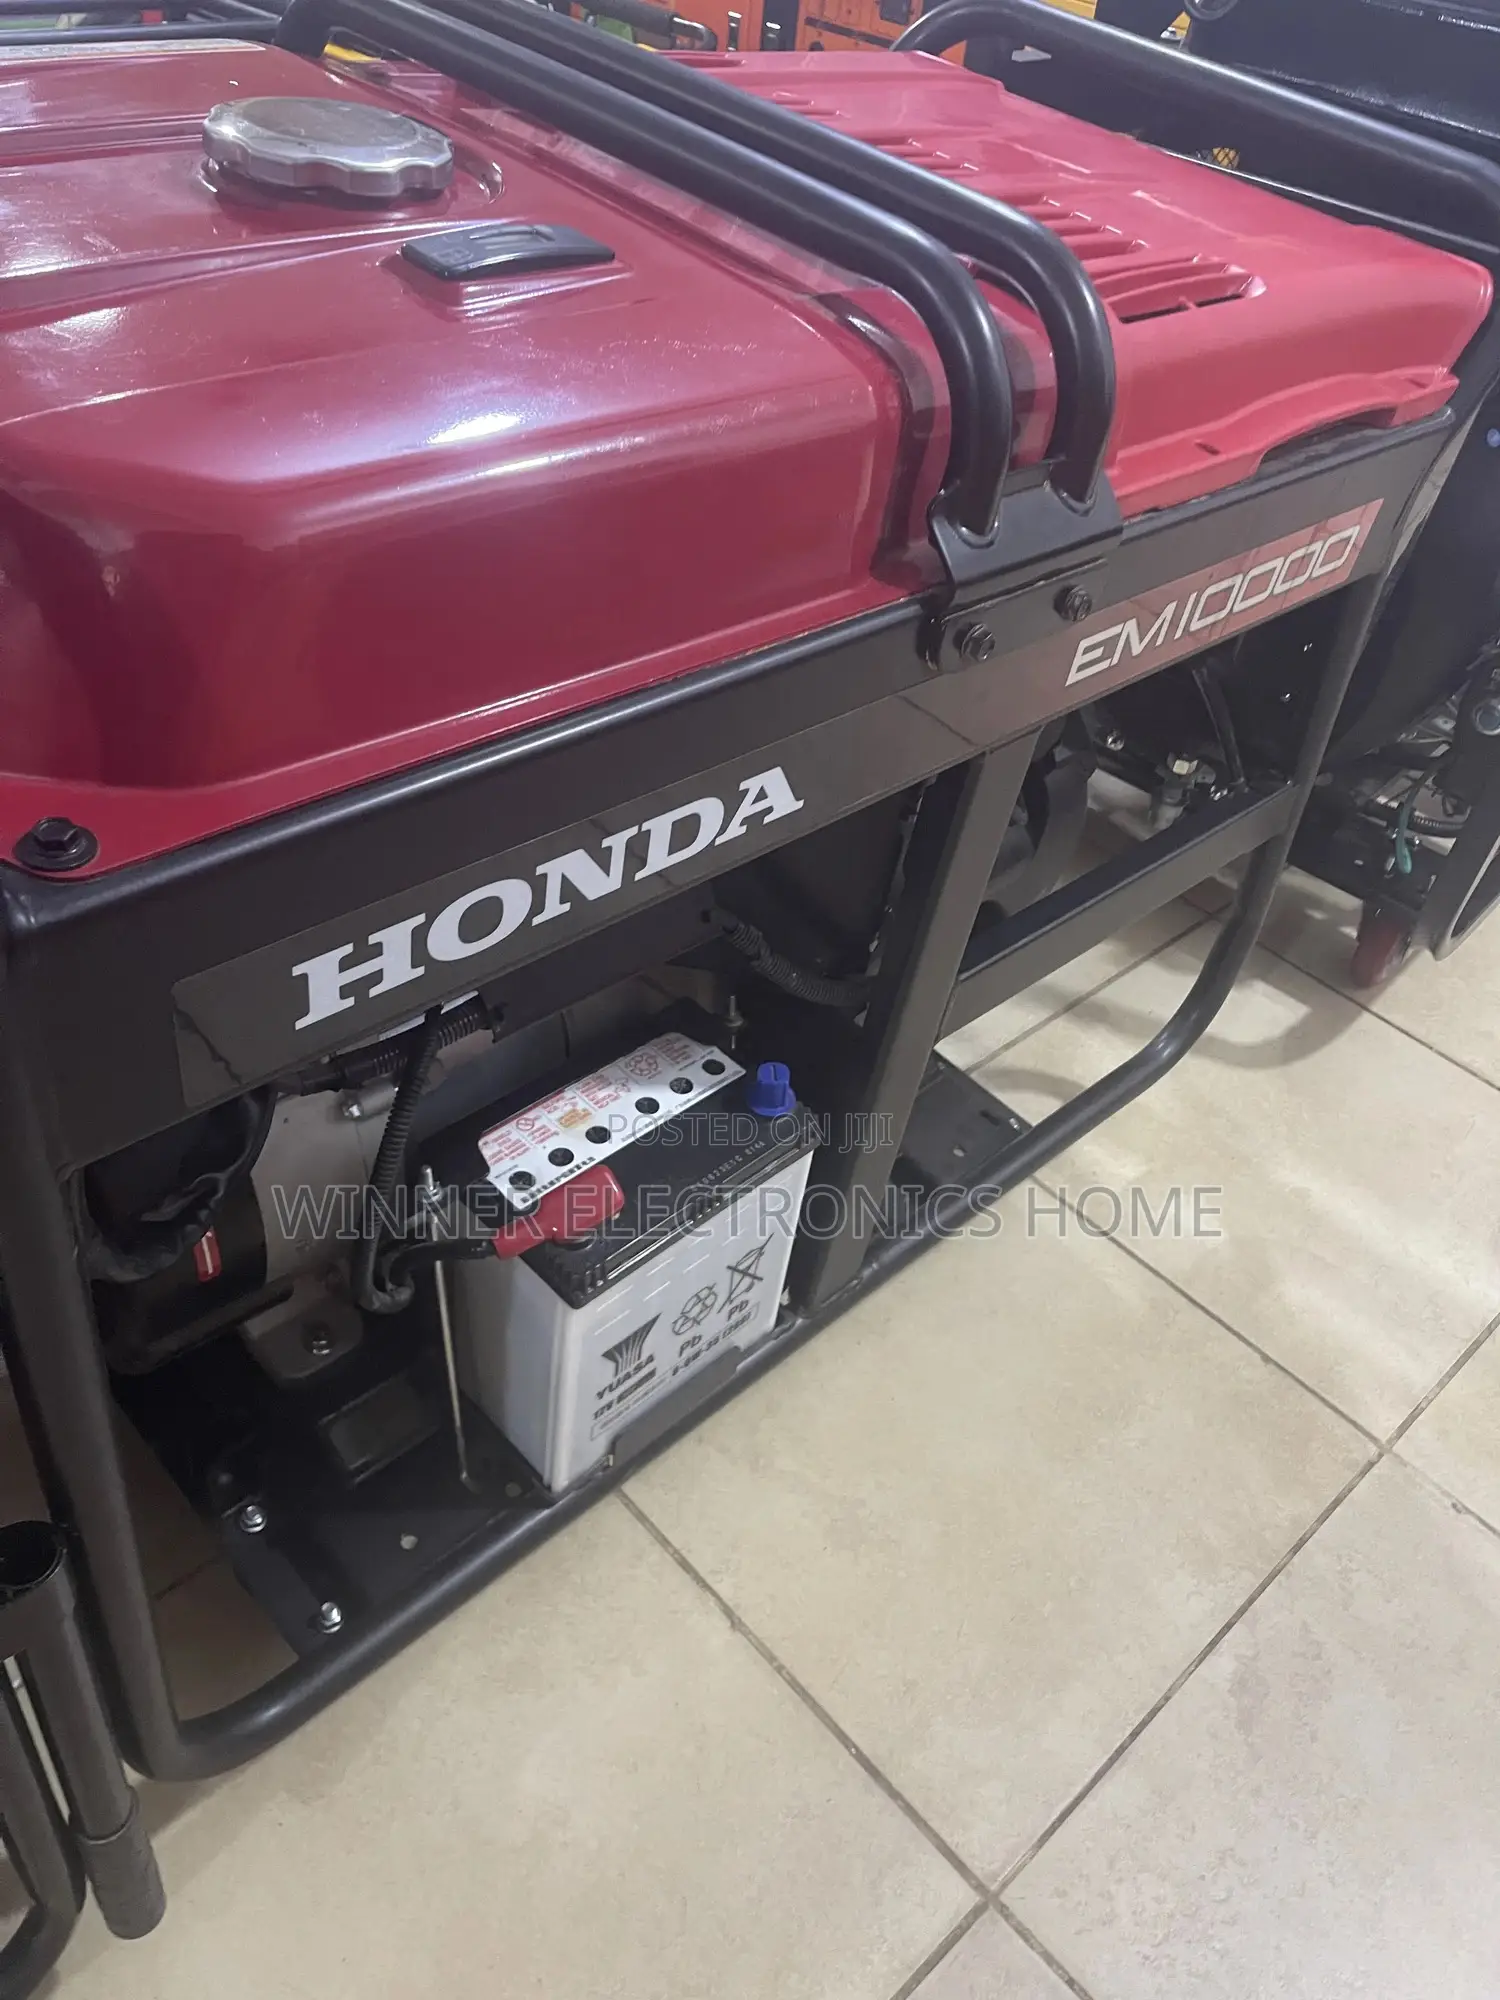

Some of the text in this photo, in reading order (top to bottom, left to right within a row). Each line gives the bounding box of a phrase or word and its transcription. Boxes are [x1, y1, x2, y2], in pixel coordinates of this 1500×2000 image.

[1065, 524, 1361, 688] EM10000
[292, 766, 805, 1031] HONDA
[595, 1352, 655, 1401] YUASA
[679, 1334, 702, 1358] Pb
